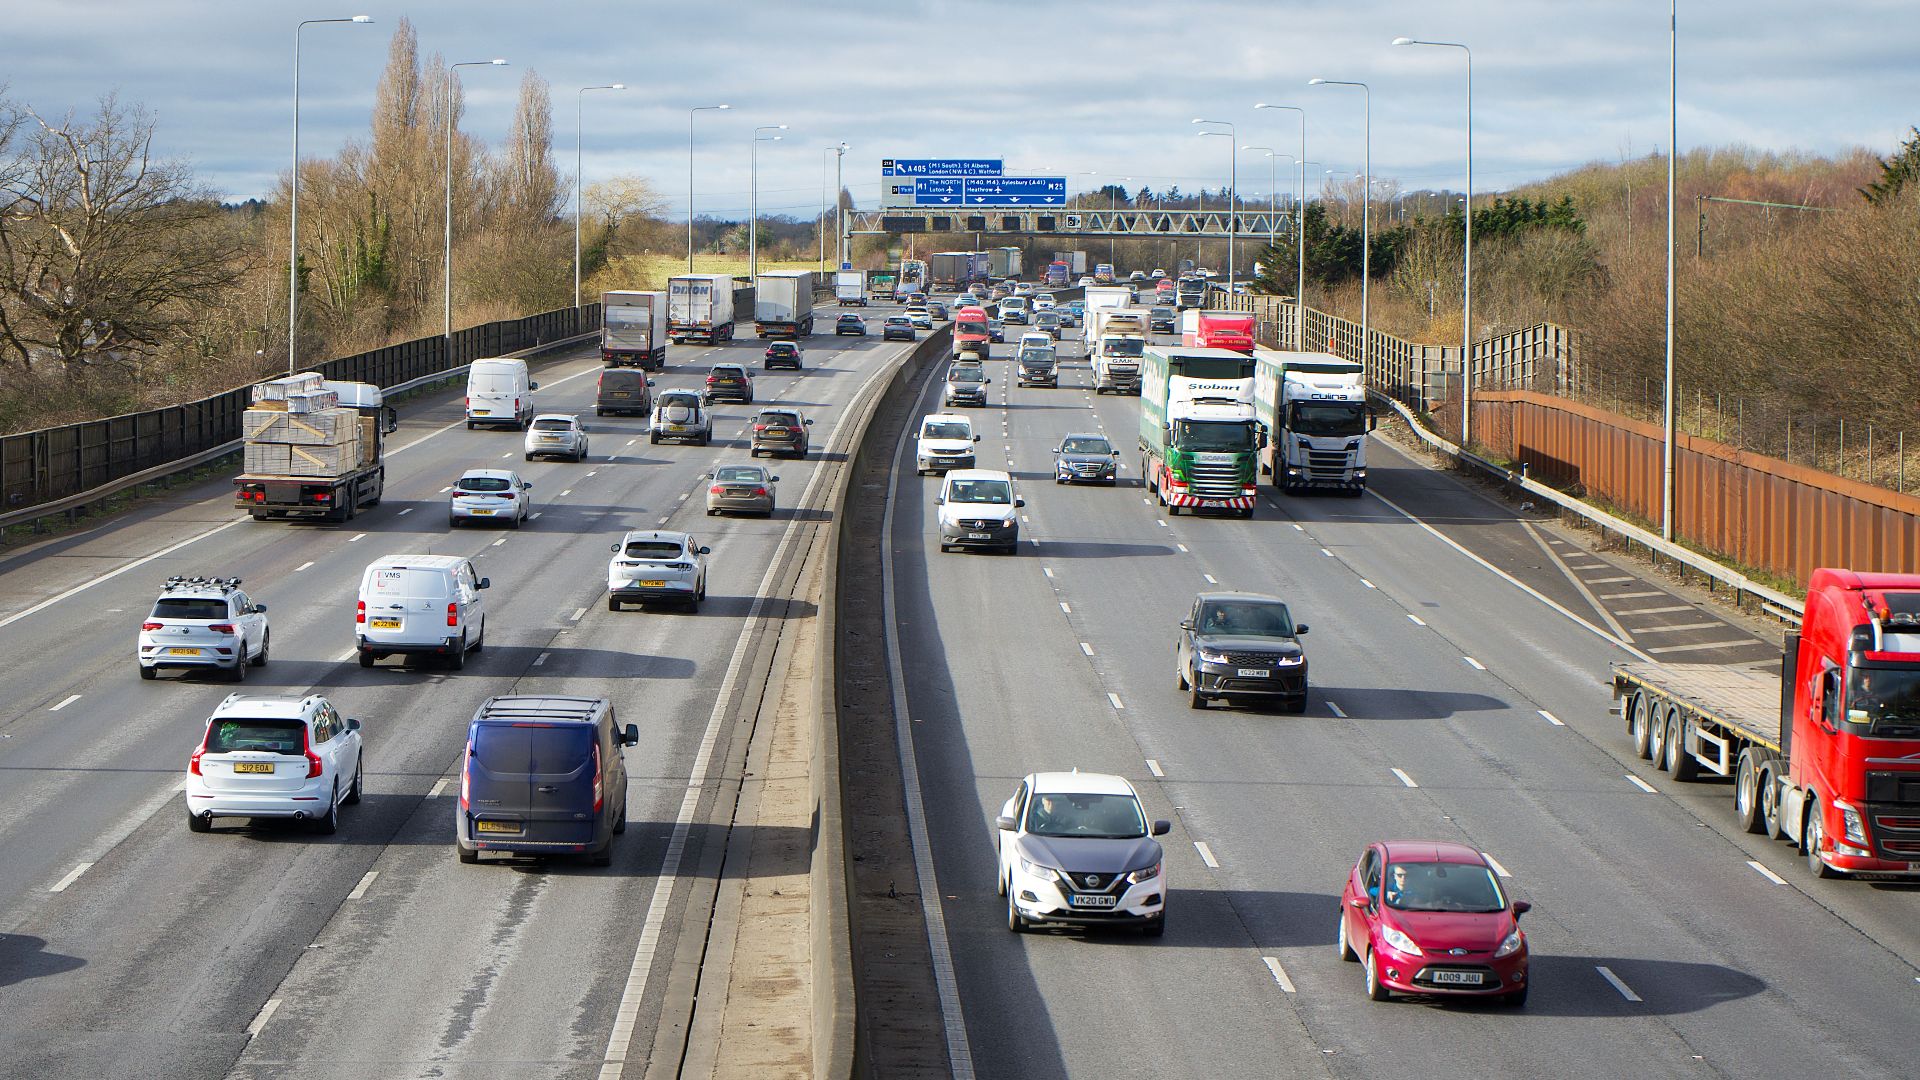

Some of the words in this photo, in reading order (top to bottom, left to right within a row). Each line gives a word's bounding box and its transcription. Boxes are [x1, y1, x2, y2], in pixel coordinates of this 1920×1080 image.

[672, 286, 709, 295] DIXON
[1075, 896, 1096, 905] VK20
[1098, 896, 1115, 905] GWU
[1462, 974, 1480, 983] JUU
